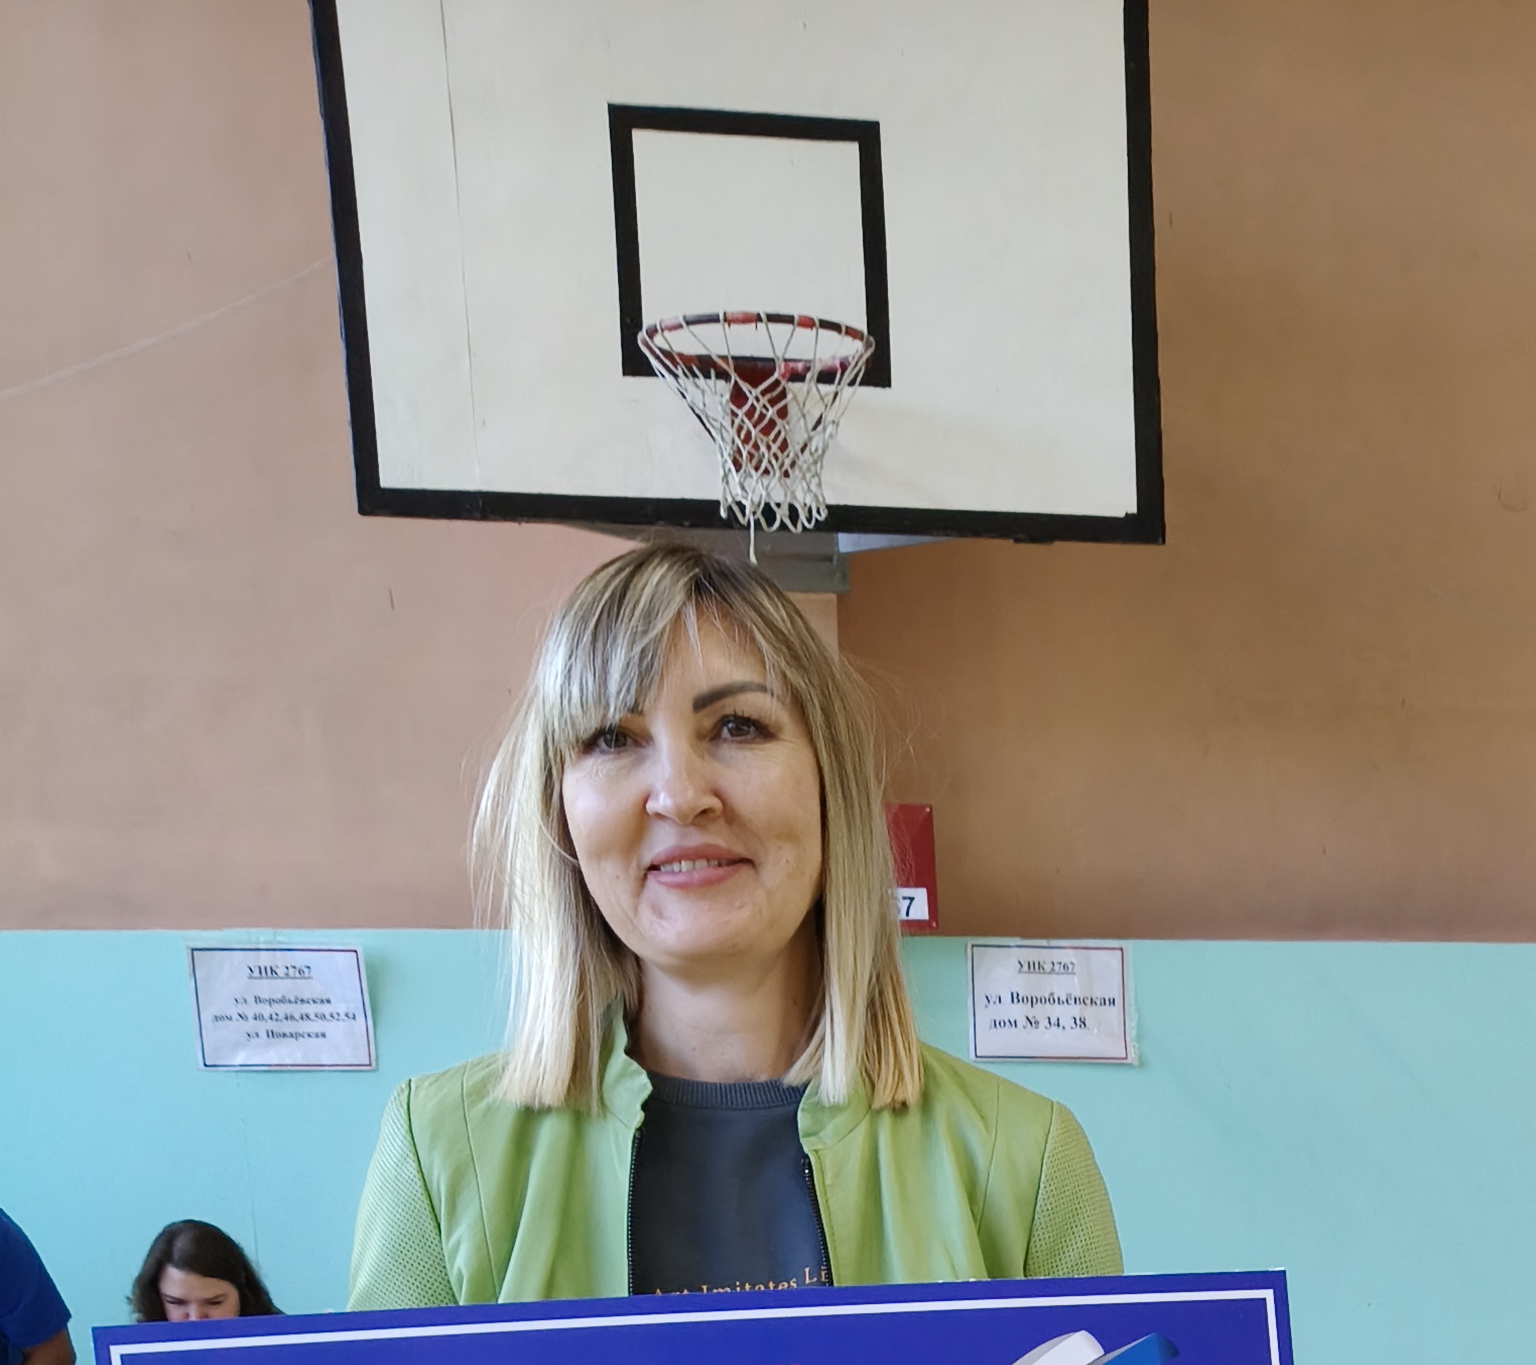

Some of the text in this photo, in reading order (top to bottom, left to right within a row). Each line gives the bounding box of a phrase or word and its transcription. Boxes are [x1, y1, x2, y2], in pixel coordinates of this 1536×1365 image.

[902, 896, 915, 917] 7
[248, 965, 312, 977] УИК 2767
[1017, 960, 1075, 973] УИК 2767
[1010, 991, 1116, 1009] Воробьёвская
[989, 1019, 1018, 1030] дом
[1023, 1016, 1040, 1030] №
[1044, 1016, 1065, 1031] 34,
